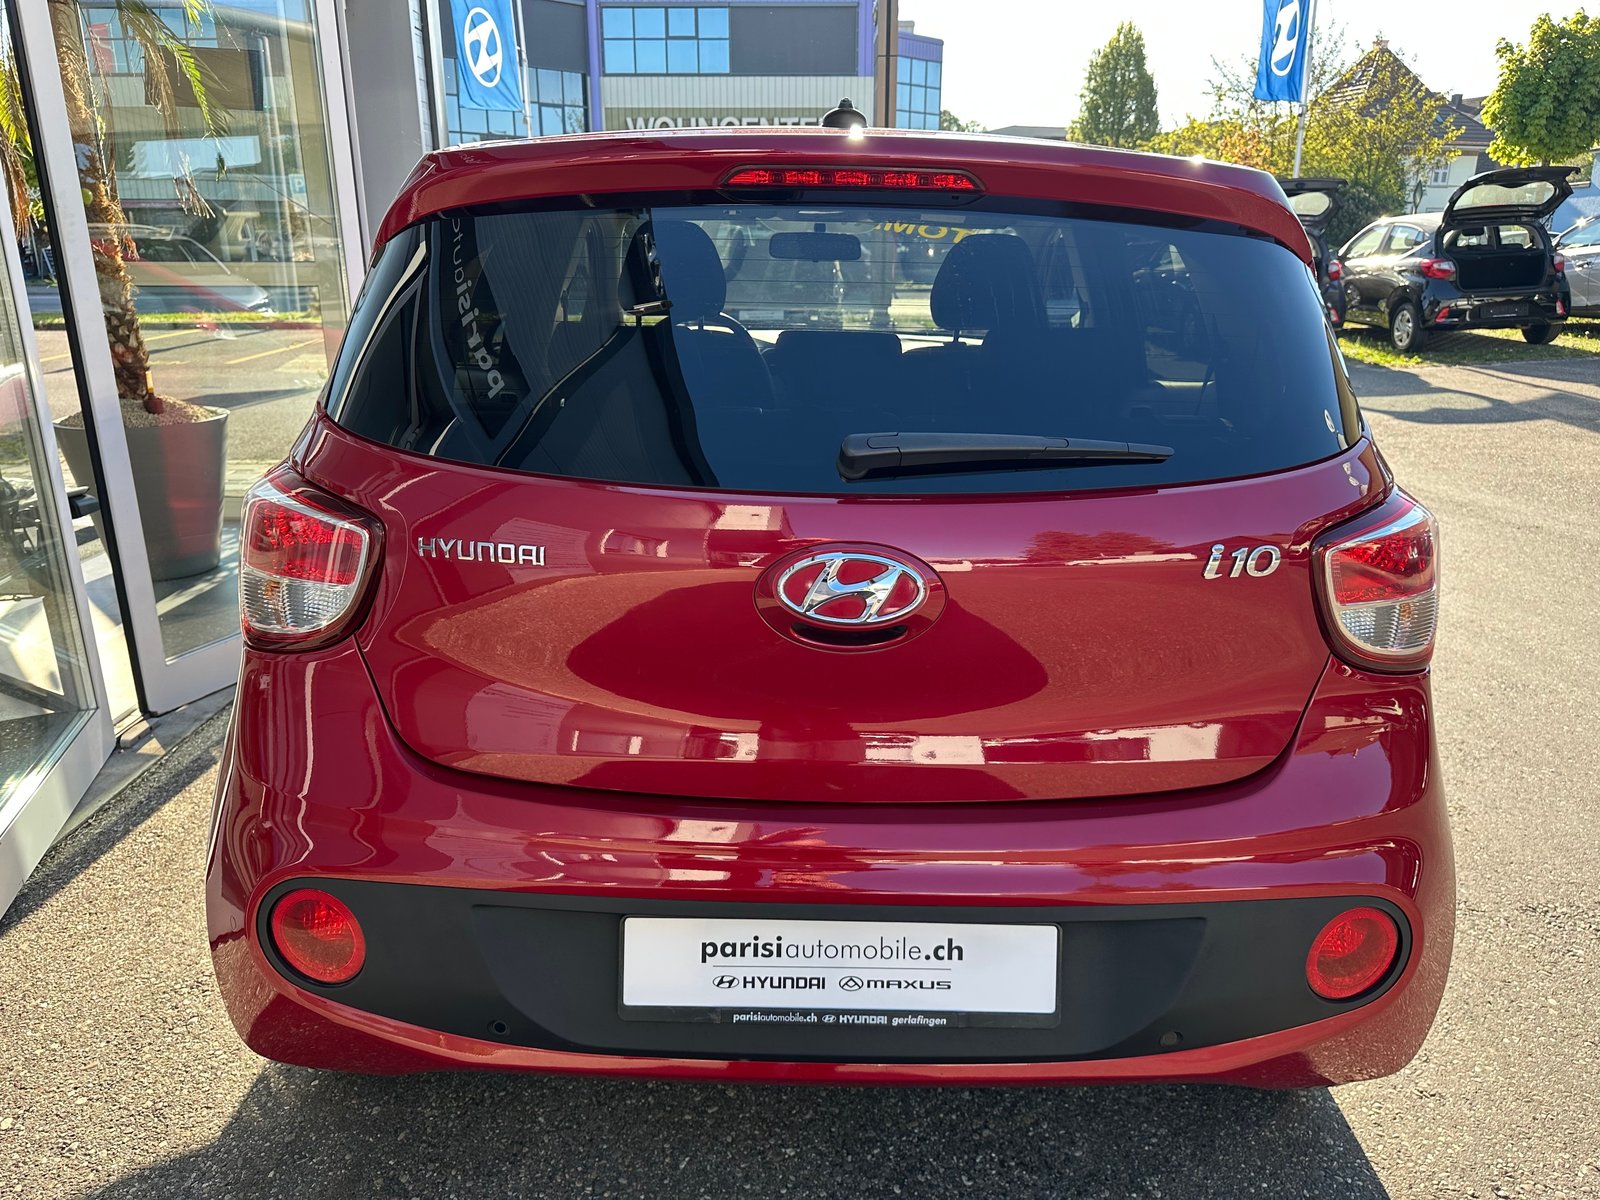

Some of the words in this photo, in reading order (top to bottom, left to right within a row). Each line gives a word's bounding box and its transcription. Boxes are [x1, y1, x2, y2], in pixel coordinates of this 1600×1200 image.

[417, 536, 546, 566] HYUNDAI
[1203, 543, 1281, 580] i10
[700, 935, 964, 964] parisiautomobile.ch
[742, 975, 826, 990] HYUNDAI
[866, 979, 952, 990] MAXUS
[732, 1011, 818, 1023] parisiautomobile.ch
[839, 1014, 888, 1025] HYUNDAI
[891, 1016, 947, 1027] gerlafingen
